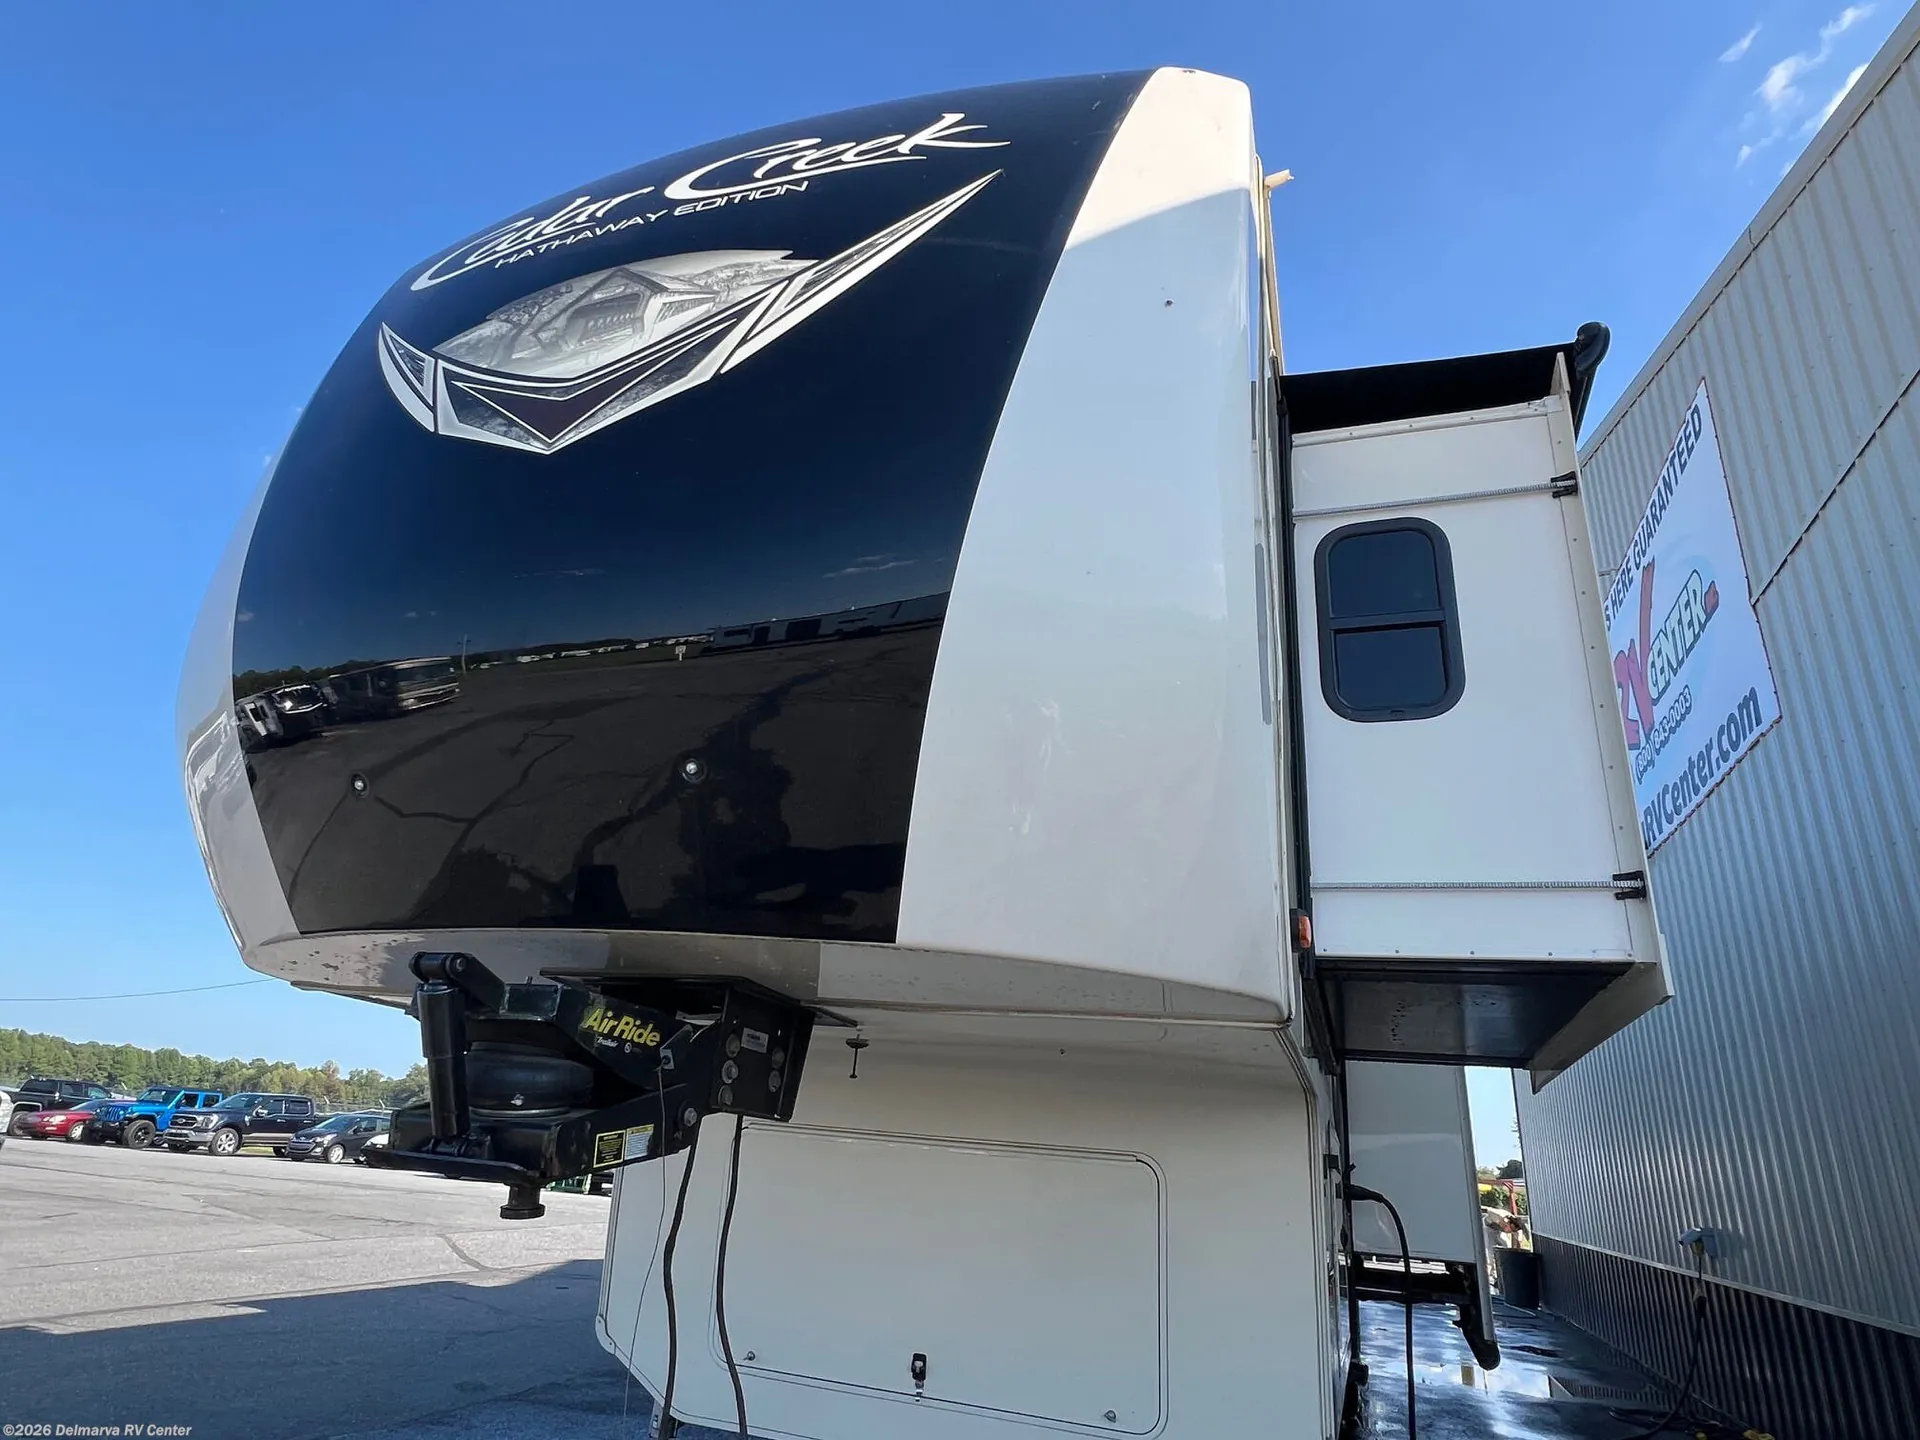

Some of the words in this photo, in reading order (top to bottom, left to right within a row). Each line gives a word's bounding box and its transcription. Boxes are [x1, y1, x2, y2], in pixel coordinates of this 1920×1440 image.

[410, 186, 655, 291] Cedar
[664, 113, 1011, 200] Creek
[494, 210, 668, 268] HATHAWAY
[673, 181, 810, 216] EDITION
[1610, 556, 1634, 620] HERE
[1633, 403, 1702, 571] GUARANTEED
[1647, 569, 1708, 706] CENTER
[1641, 687, 1763, 850] RVCenter.com
